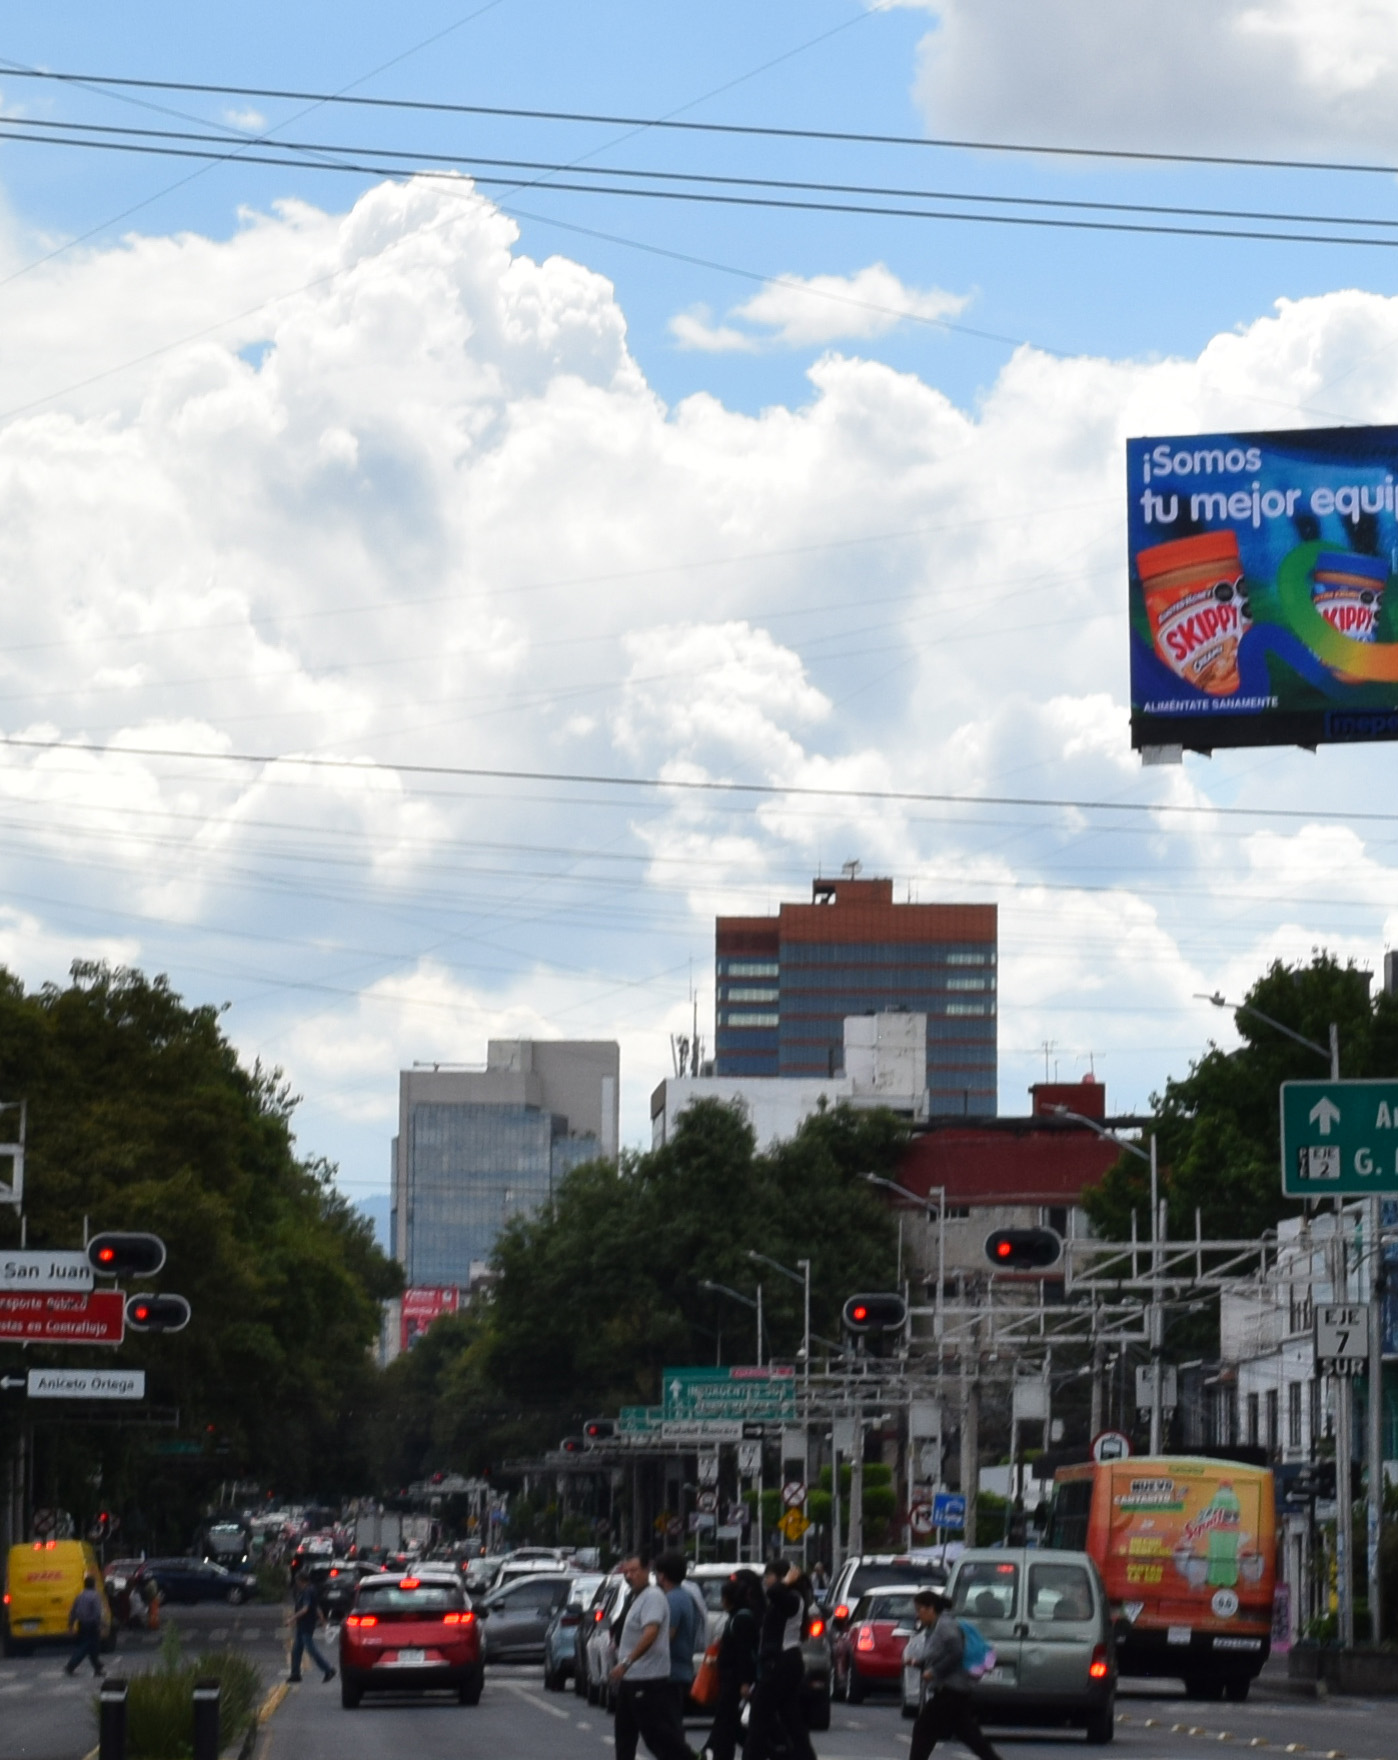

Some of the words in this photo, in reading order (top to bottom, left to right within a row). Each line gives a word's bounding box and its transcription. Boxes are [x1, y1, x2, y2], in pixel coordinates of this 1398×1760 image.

[1143, 444, 1262, 485] ¡Somos
[1140, 487, 1179, 524] tu
[1190, 480, 1302, 529] mejor
[1322, 606, 1373, 632] KIPPY
[1166, 603, 1238, 661] SKIPPY
[1211, 695, 1280, 711] SANAMENTE
[1319, 1159, 1330, 1177] 2
[1353, 1147, 1383, 1176] G.
[4, 1261, 40, 1279] San
[49, 1262, 90, 1279] Juan
[1324, 1308, 1360, 1326] EJE
[1335, 1331, 1350, 1354] 7
[1321, 1358, 1364, 1376] SUR
[37, 1376, 86, 1391] Aniceto
[91, 1377, 135, 1393] Ortega
